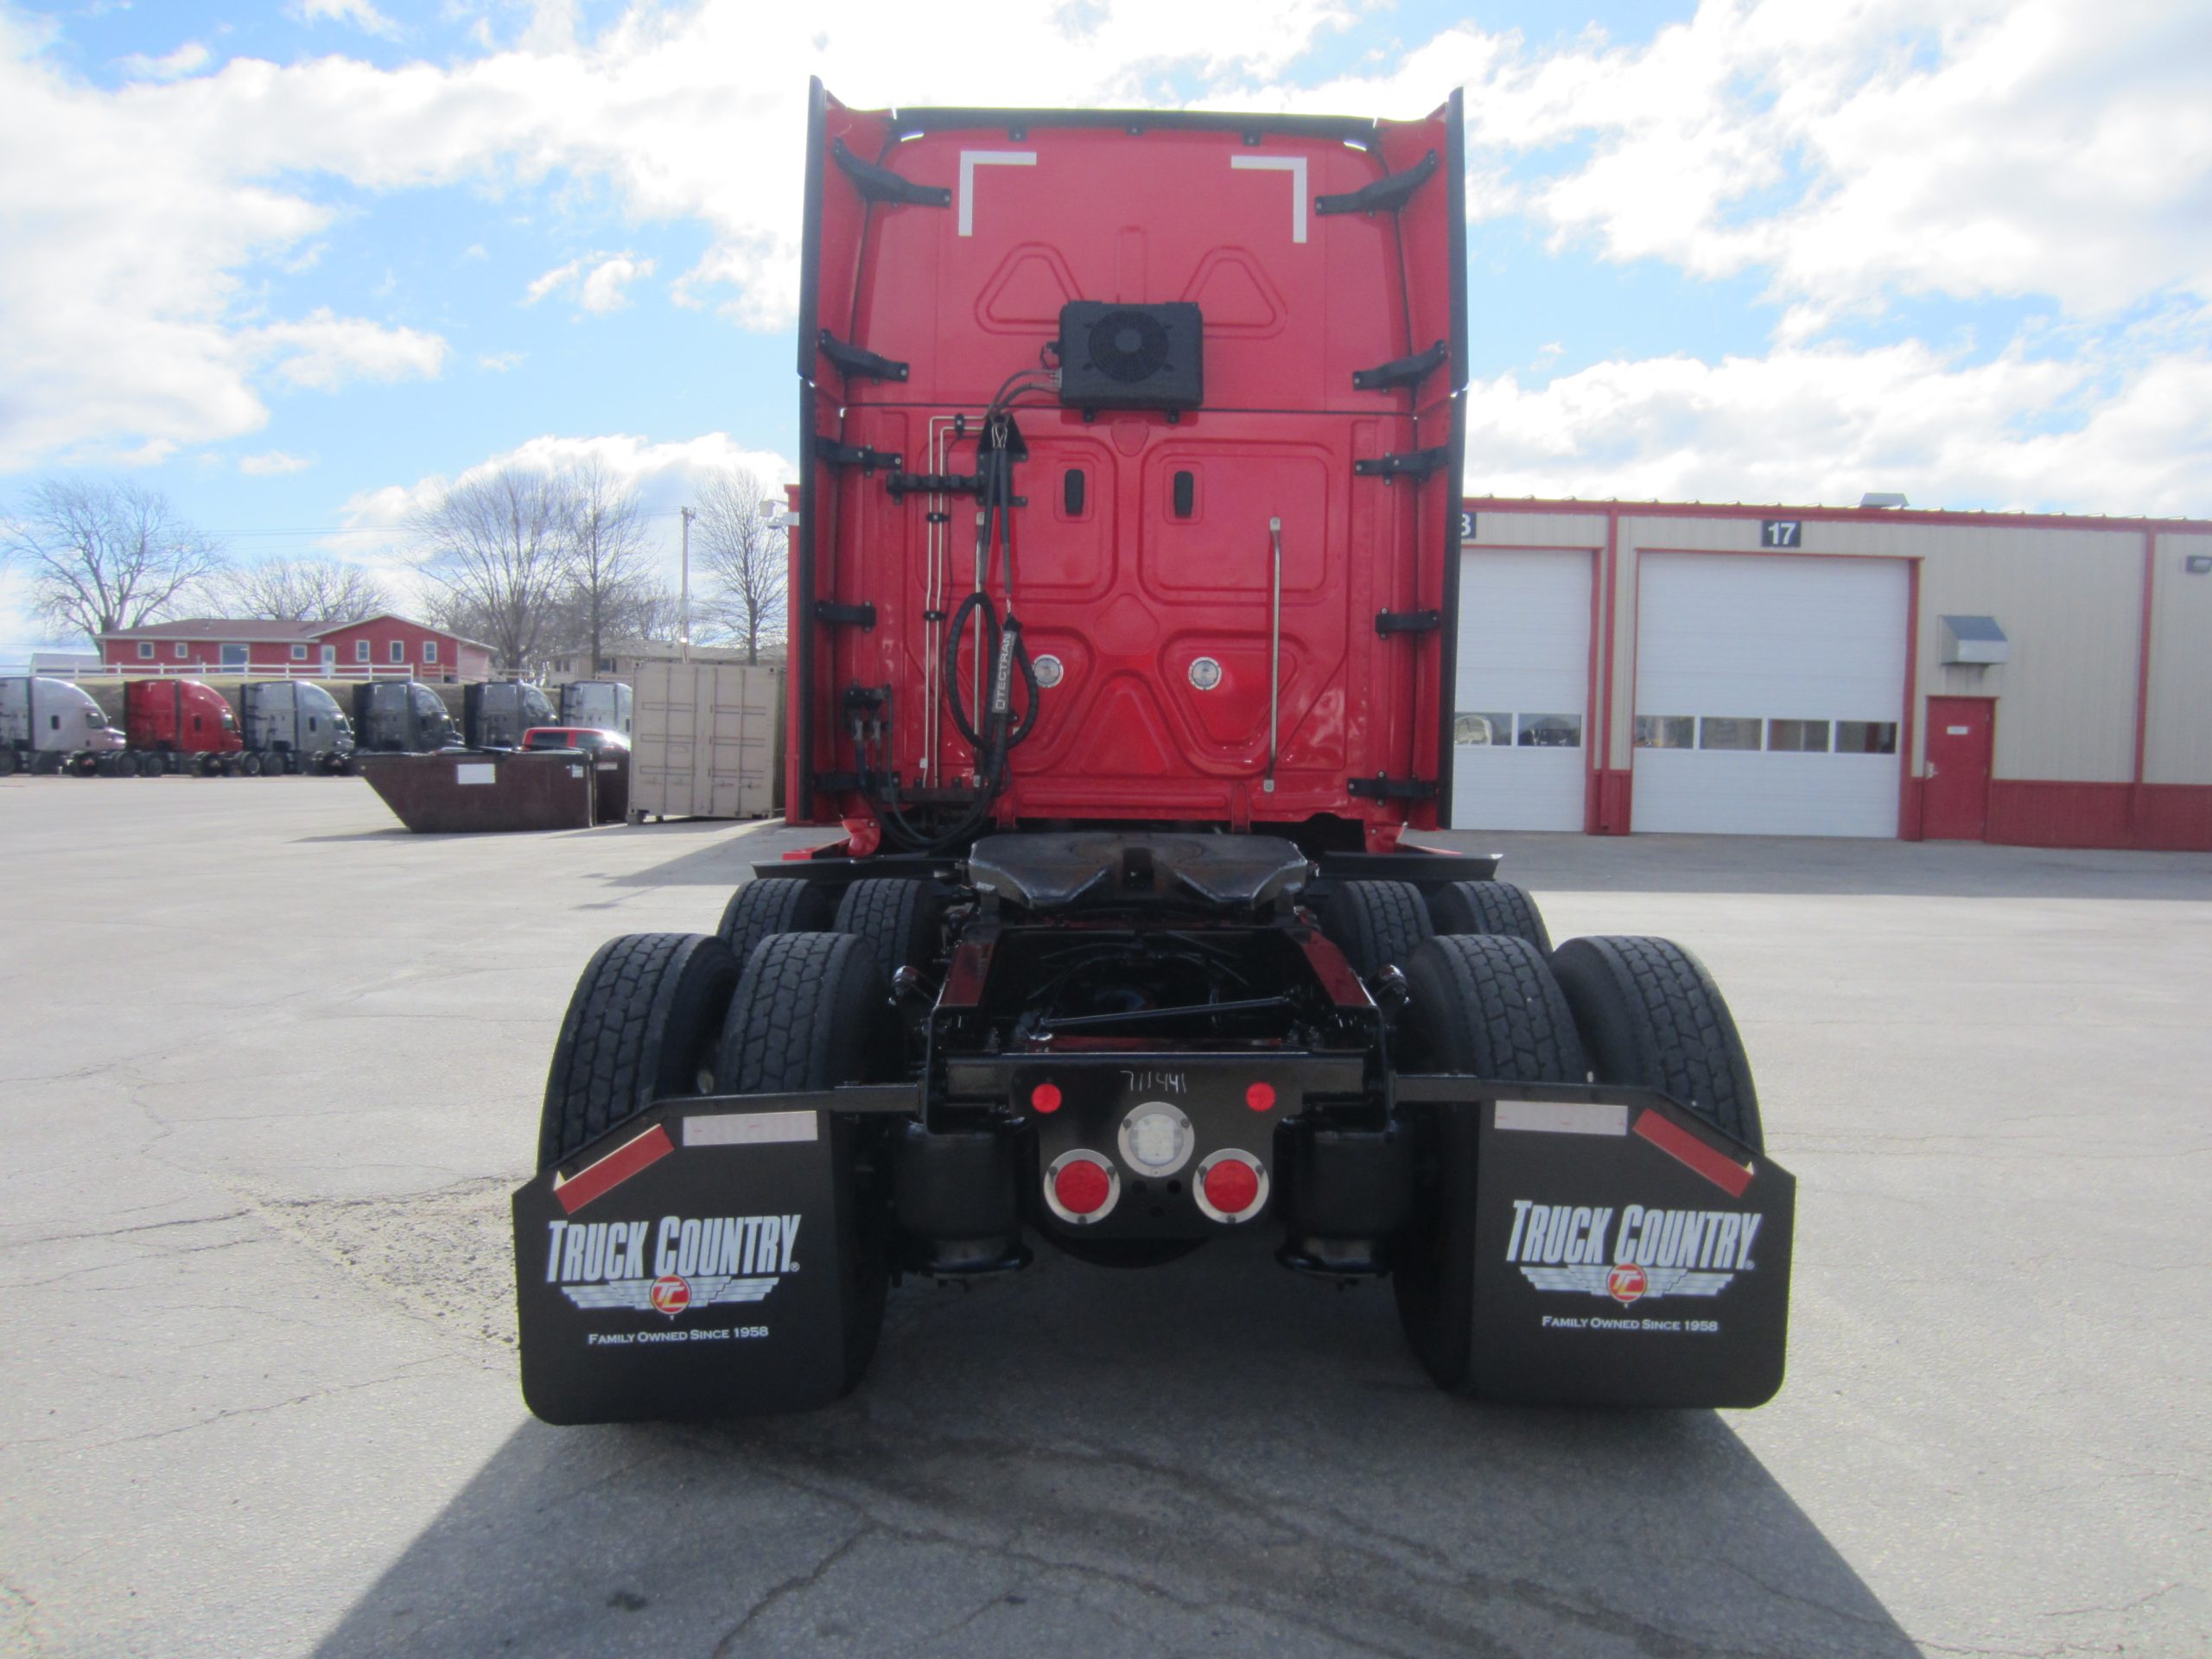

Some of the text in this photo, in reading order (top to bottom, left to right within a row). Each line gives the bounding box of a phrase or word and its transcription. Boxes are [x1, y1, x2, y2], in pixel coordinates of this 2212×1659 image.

[1768, 523, 1796, 544] 17
[996, 632, 1011, 698] TECTRAN
[1120, 1071, 1186, 1093] 711441
[1506, 1200, 1613, 1264] TRUCK
[546, 1220, 650, 1283] TRUCK
[588, 1325, 769, 1344] FAMILY OWNED SINCE 1958
[1542, 1316, 1718, 1332] FAMILY OWNED SINCE 1958
